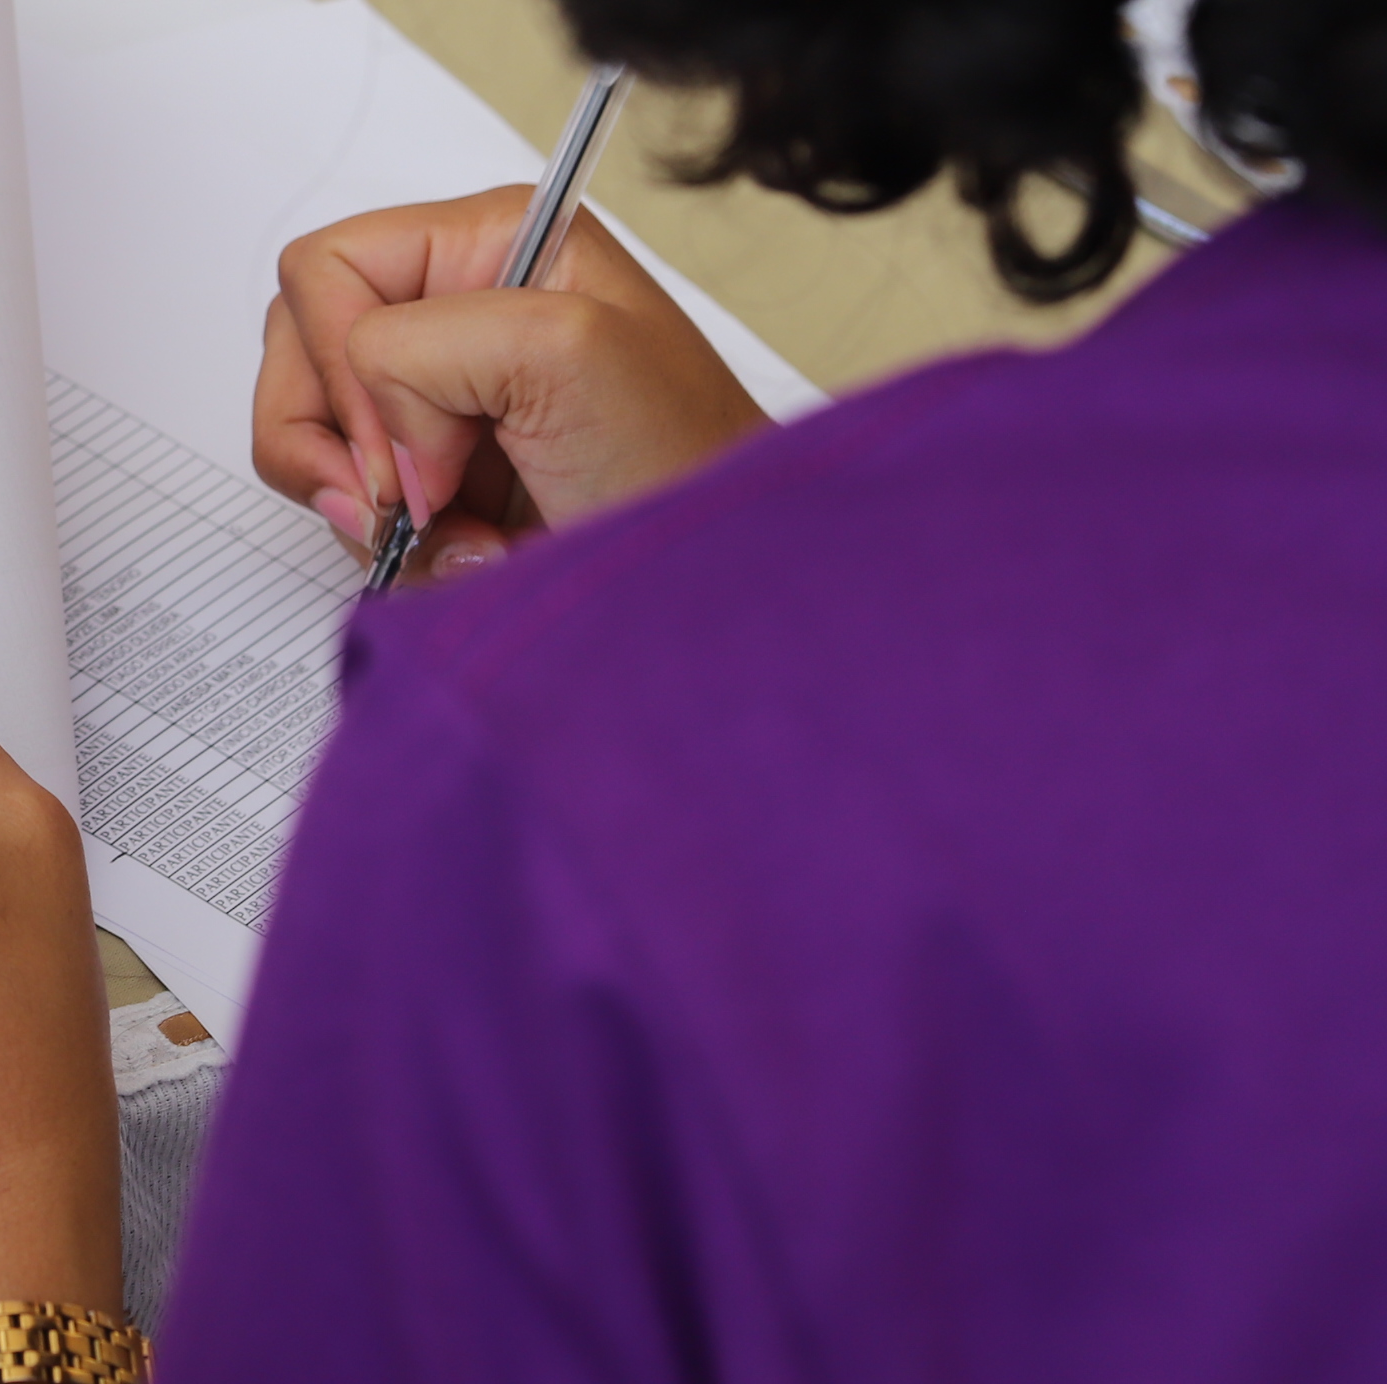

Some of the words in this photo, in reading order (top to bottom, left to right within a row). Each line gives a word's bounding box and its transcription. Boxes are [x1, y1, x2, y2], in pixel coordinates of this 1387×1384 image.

[161, 680, 213, 718] VANESSA
[81, 762, 171, 830] PARTICIPANTE
[100, 773, 190, 840] PARTICIPANTE
[118, 784, 208, 851] PARTICIPANTE
[137, 796, 226, 862] PARTICIPANTE
[156, 808, 246, 873] PARTICIPANTE
[176, 820, 264, 885] PARTICIPANTE
[195, 832, 283, 897] PARTICIPANTE
